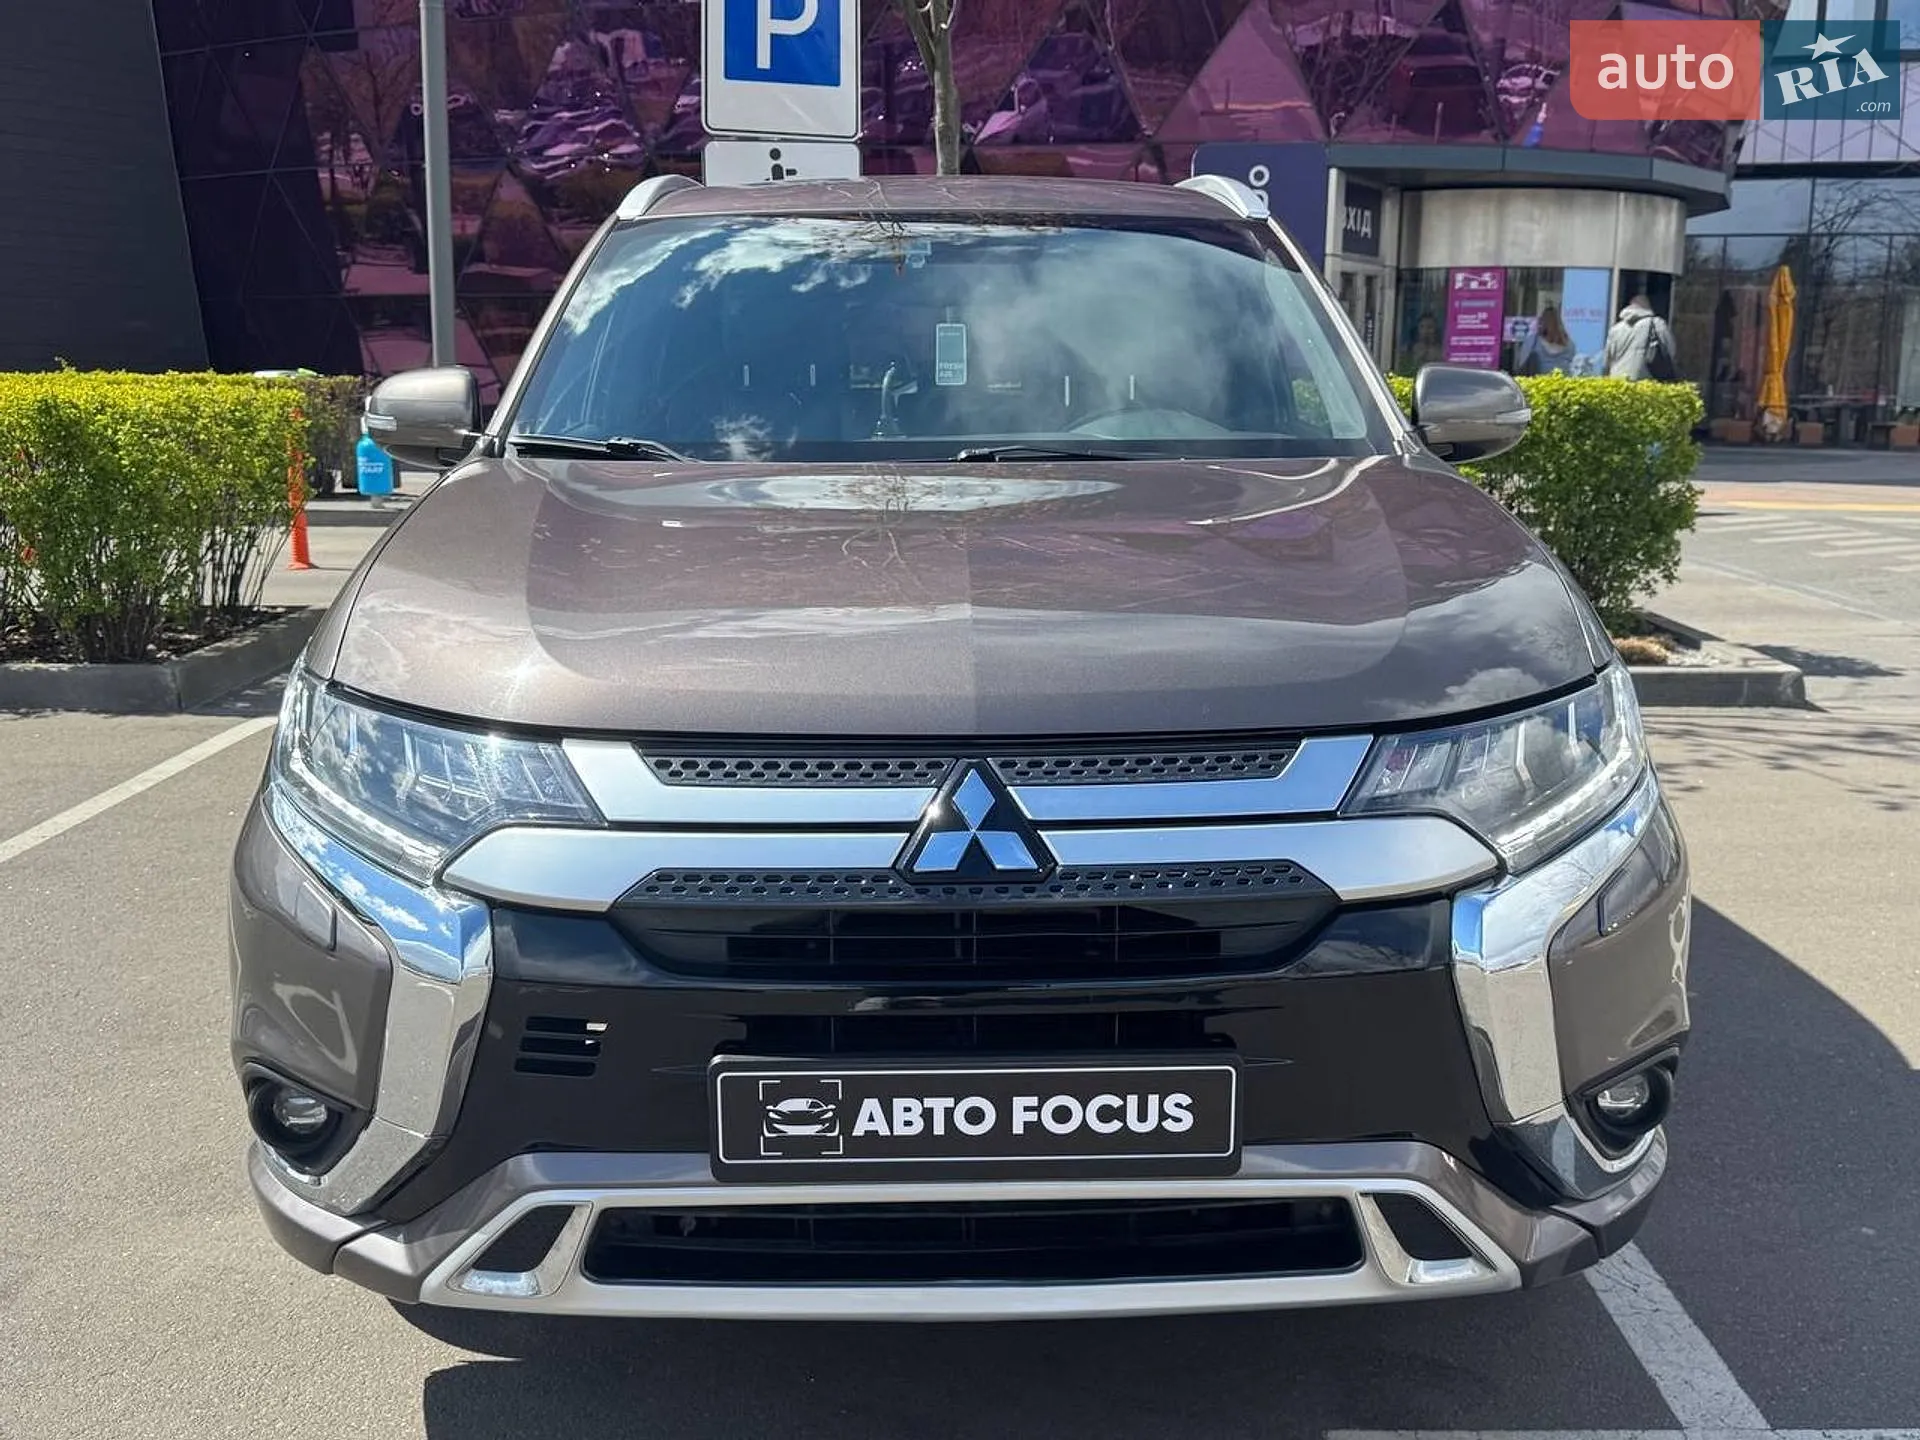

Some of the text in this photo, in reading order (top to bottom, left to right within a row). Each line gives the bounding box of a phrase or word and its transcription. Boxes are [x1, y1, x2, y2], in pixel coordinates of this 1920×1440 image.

[756, 0, 819, 69] P
[852, 1093, 1195, 1137] АВТО FOCUS
